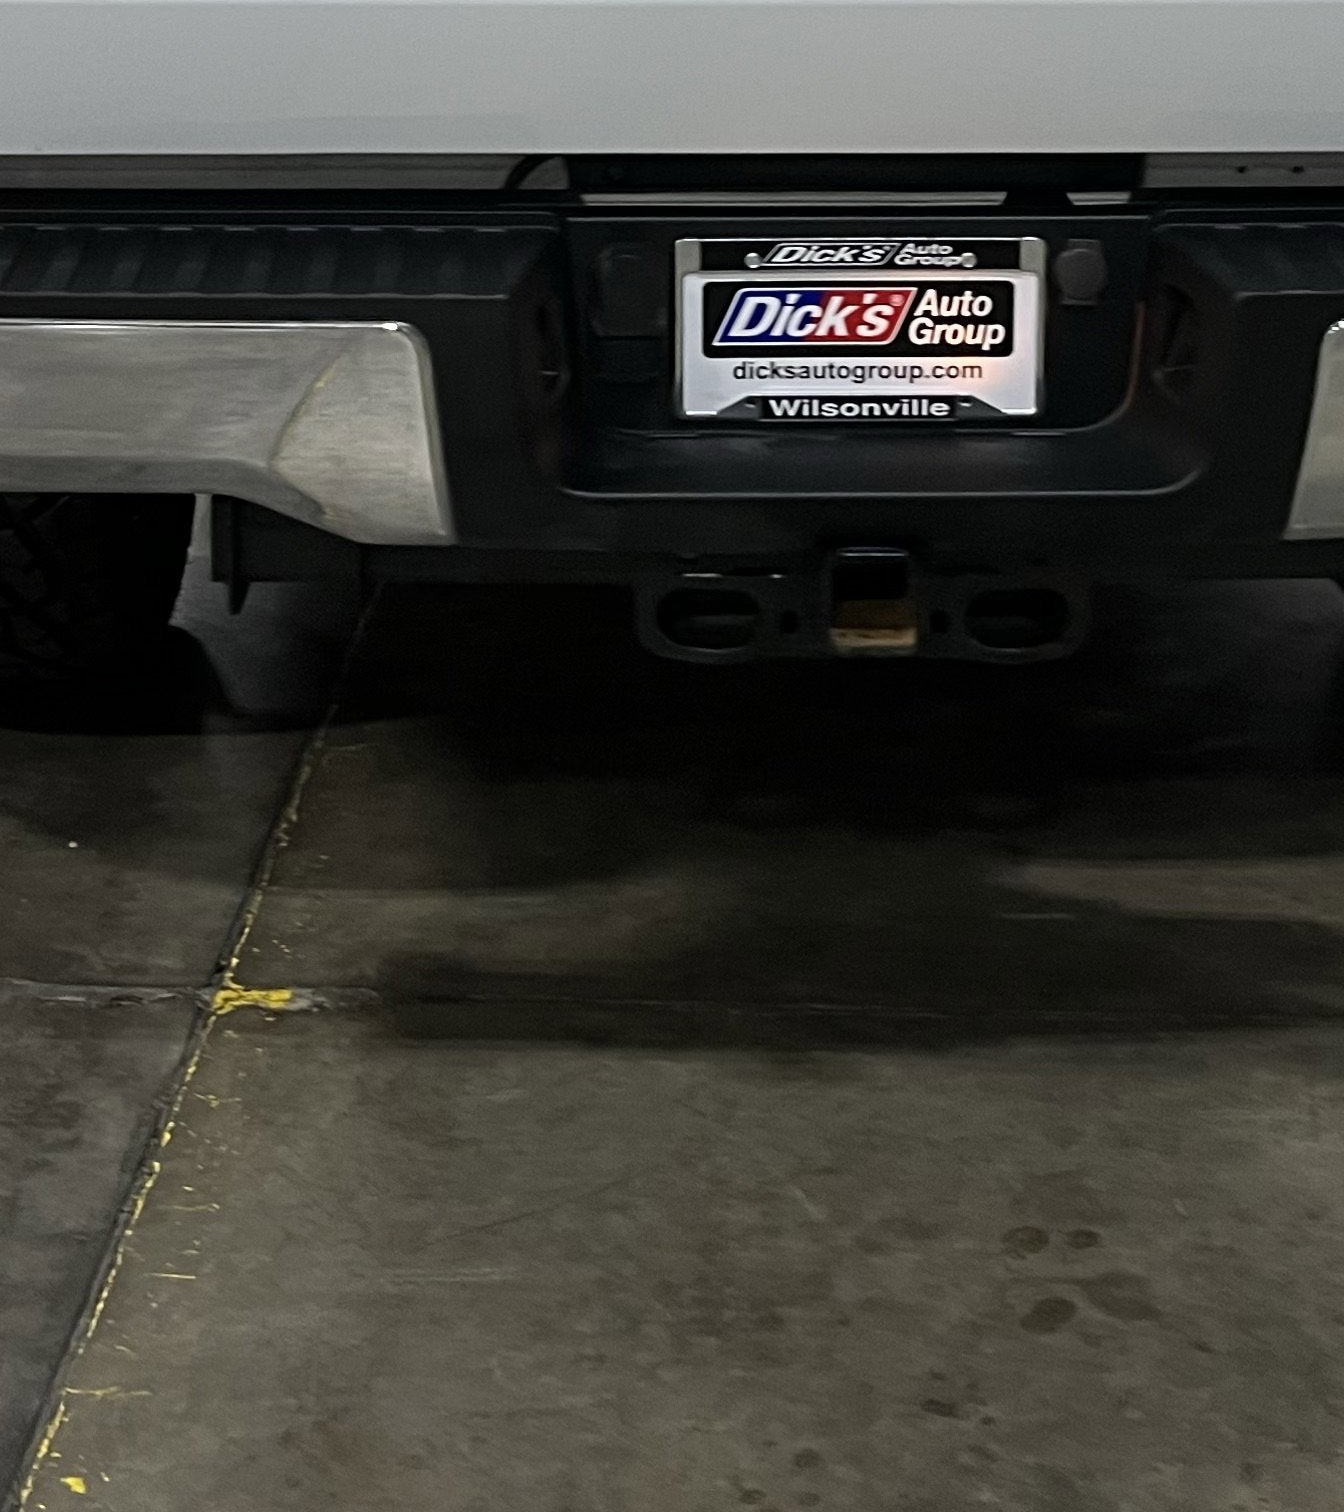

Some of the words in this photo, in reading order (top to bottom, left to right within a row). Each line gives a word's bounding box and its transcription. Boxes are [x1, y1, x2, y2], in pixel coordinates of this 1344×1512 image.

[770, 245, 887, 264] Dick's
[900, 243, 954, 255] Auto
[894, 254, 963, 268] Group
[913, 288, 993, 318] Auto
[726, 292, 895, 338] Dick's
[908, 317, 1006, 351] Group
[733, 361, 984, 384] dicksautogroup.com
[769, 398, 951, 418] Wilsonville
